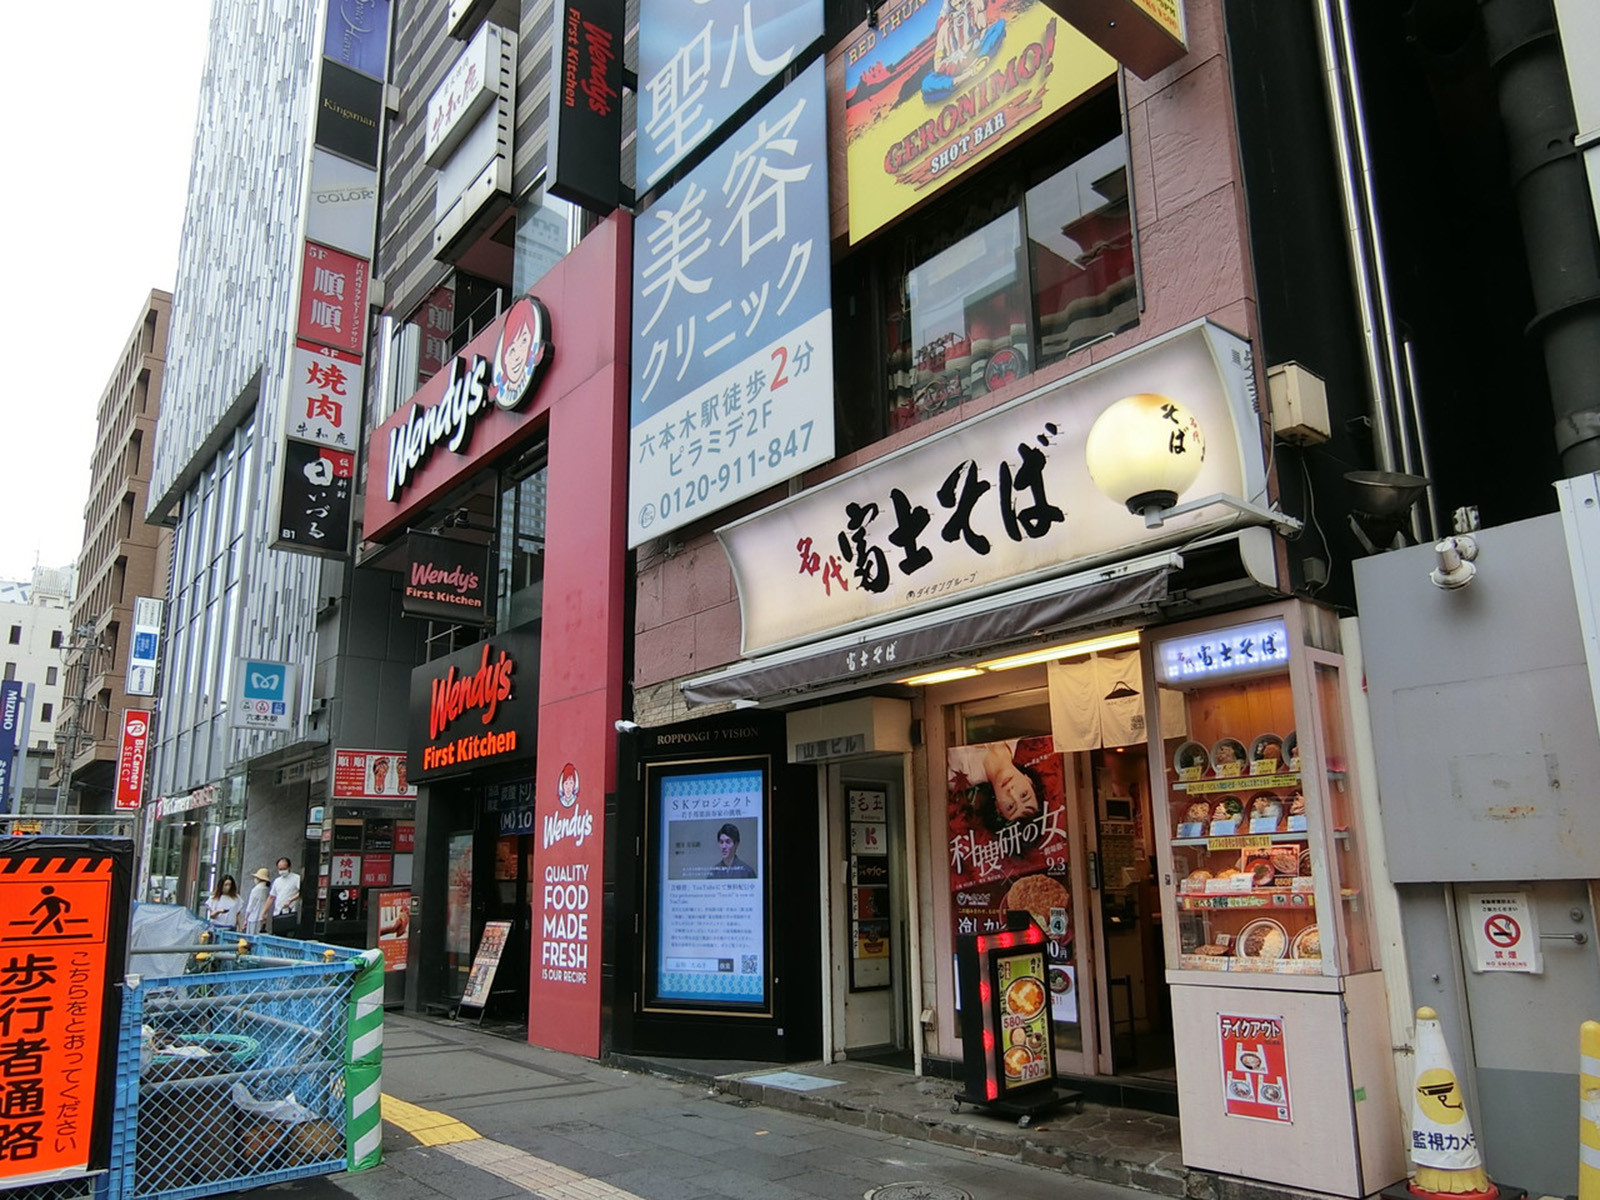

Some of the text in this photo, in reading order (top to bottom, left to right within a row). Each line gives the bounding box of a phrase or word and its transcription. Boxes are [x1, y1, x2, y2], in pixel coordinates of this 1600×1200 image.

[565, 7, 580, 107] First Kitchen
[581, 20, 618, 117] Wendy's
[849, 32, 877, 66] RED
[324, 98, 376, 128] Kingsman
[884, 17, 1058, 175] GERONIMO!
[930, 112, 1006, 174] SHOT BAR
[641, 98, 813, 337] 美容
[309, 247, 328, 259] 5F
[311, 266, 346, 333] 順順
[641, 238, 813, 404] クリニック
[320, 347, 339, 358] 4F
[306, 361, 349, 428] 焼肉
[639, 339, 815, 465] 六本木駅徒歩2分
[386, 355, 487, 502] Wendy's
[669, 399, 773, 478] ピラミデ2F
[1160, 403, 1187, 455] そば
[659, 419, 815, 520] 0120-911-847
[797, 421, 1066, 597] 名代 富士そば
[282, 528, 296, 540] B1
[406, 586, 482, 607] First Kitchen
[411, 562, 479, 593] Wendy's
[846, 640, 898, 671] 富士そば
[1197, 631, 1278, 667] 富士そば
[3, 689, 19, 731] MIZUHO
[429, 643, 514, 740] Wendy's
[423, 730, 517, 771] First Kitchen
[657, 727, 760, 746] ROPPONGI 7 VISION
[122, 745, 133, 783] SELECT
[130, 739, 145, 791] BicCamera
[543, 804, 593, 850] Wendy's
[950, 800, 1067, 878] 科捜研の女
[340, 858, 353, 879] 焼肉
[545, 864, 589, 883] QUALITY
[1046, 856, 1066, 873] 9.3
[544, 884, 589, 911] FOOD
[542, 913, 588, 941] MADE
[542, 941, 588, 969] FRESH
[1494, 950, 1518, 959] 禁煙
[542, 967, 587, 985] IS OUR RECIPE
[1222, 1019, 1281, 1038] テイクアウト
[0, 953, 57, 1162] 歩行者通路
[54, 951, 92, 1153] こちらをとおってください
